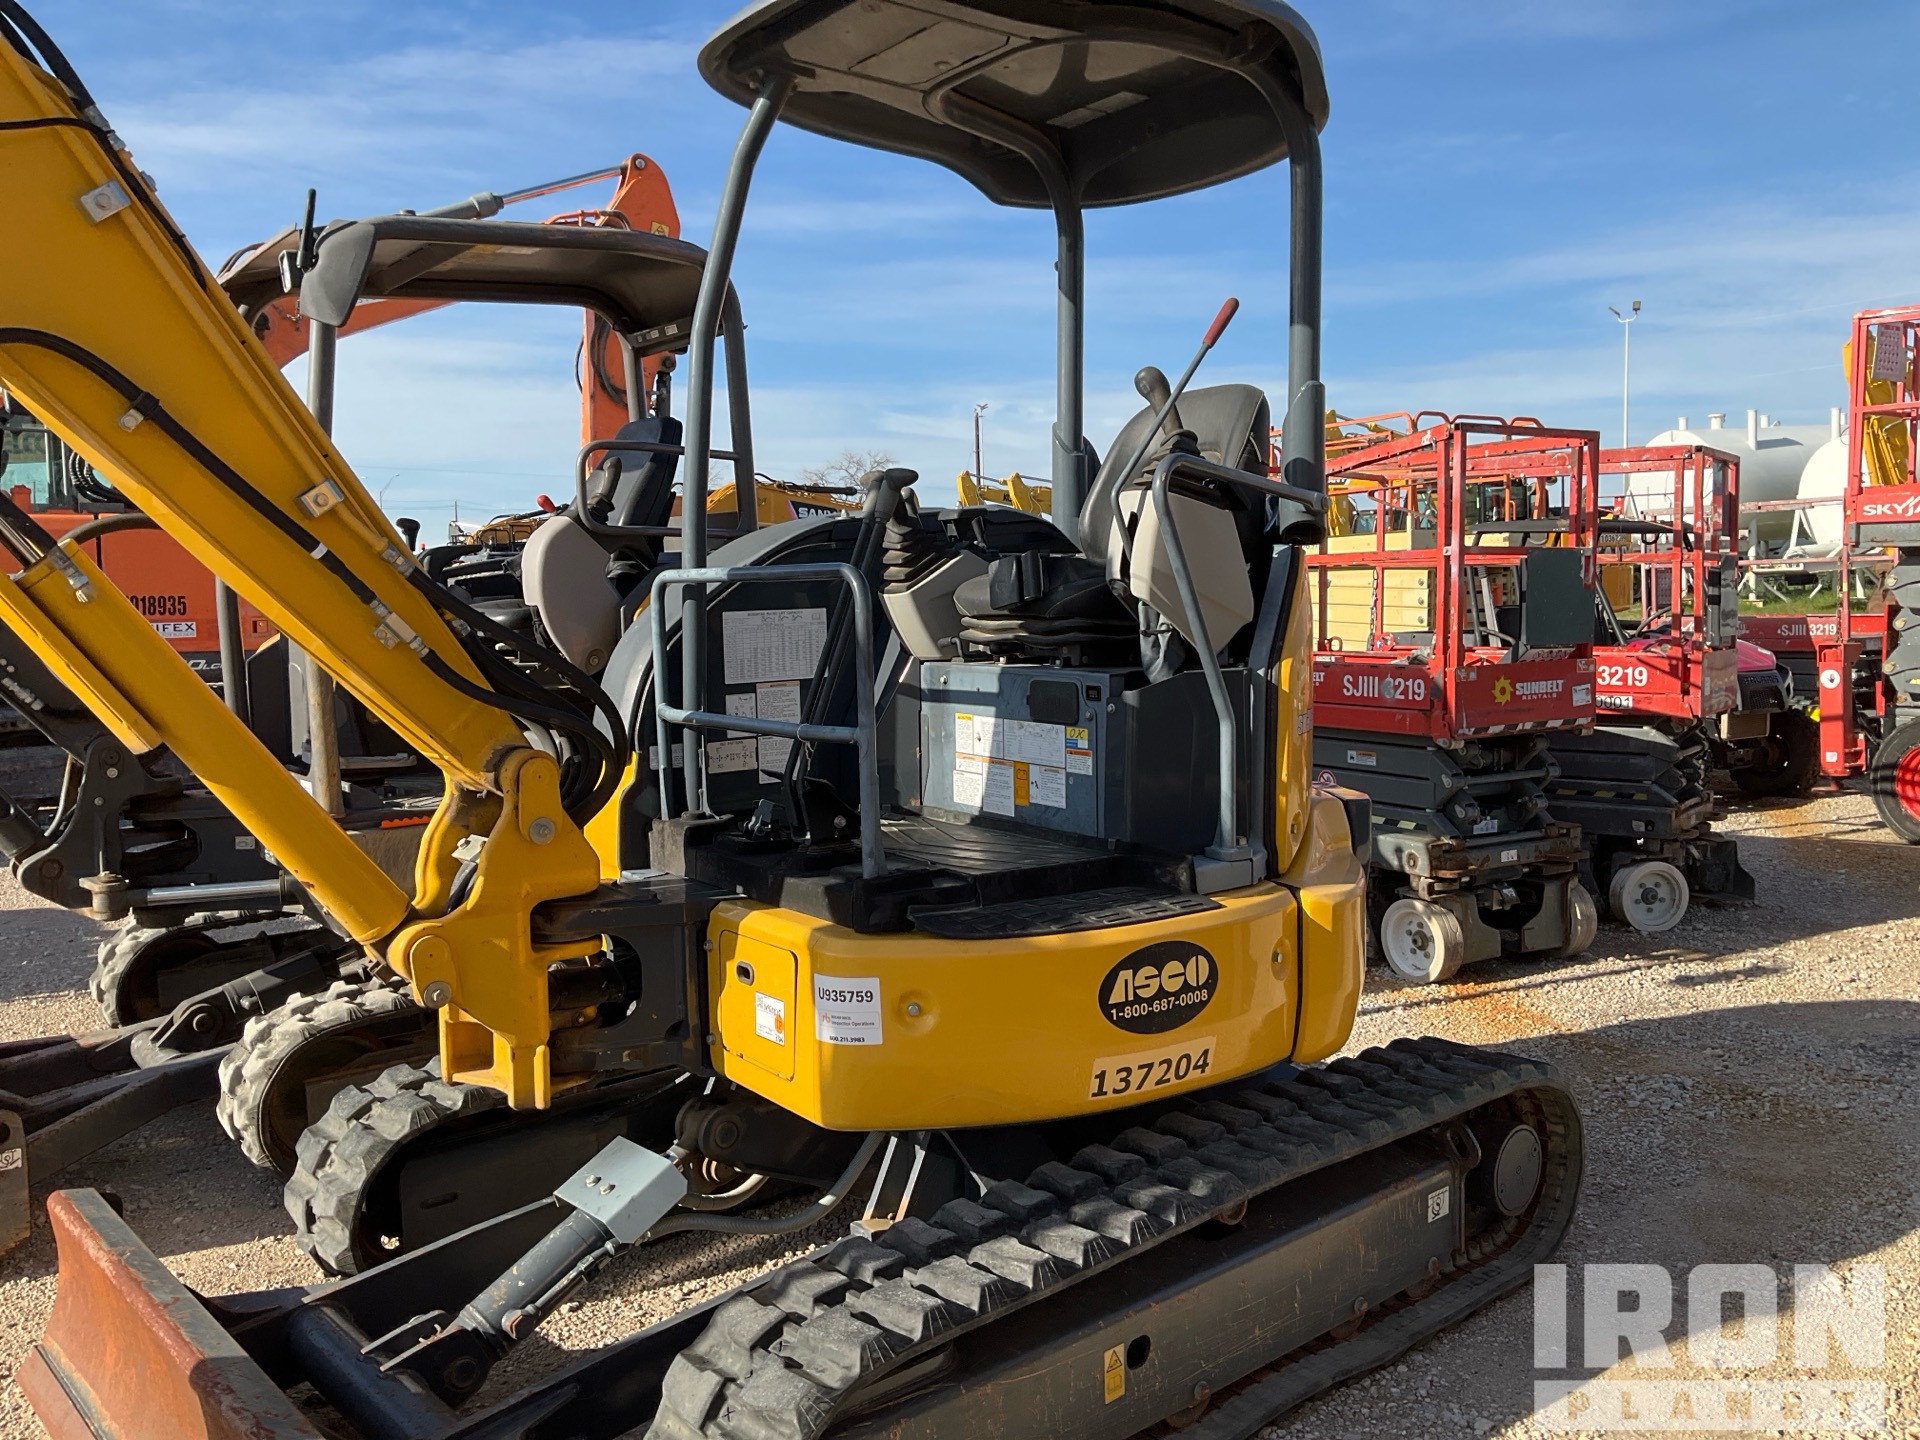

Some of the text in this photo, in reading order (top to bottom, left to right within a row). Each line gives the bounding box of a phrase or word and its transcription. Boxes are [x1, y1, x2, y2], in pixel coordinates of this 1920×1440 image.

[1781, 623, 1837, 636] SJIII 3219
[1343, 674, 1379, 698] SJIII
[1382, 675, 1425, 701] 3219
[1515, 680, 1563, 695] SUNBELT
[1596, 665, 1648, 687] 3219
[1108, 955, 1210, 1005] ASCO
[818, 987, 874, 1003] U935759
[1110, 989, 1209, 1021] 1-800-687-0008
[1091, 1048, 1210, 1098] 137204
